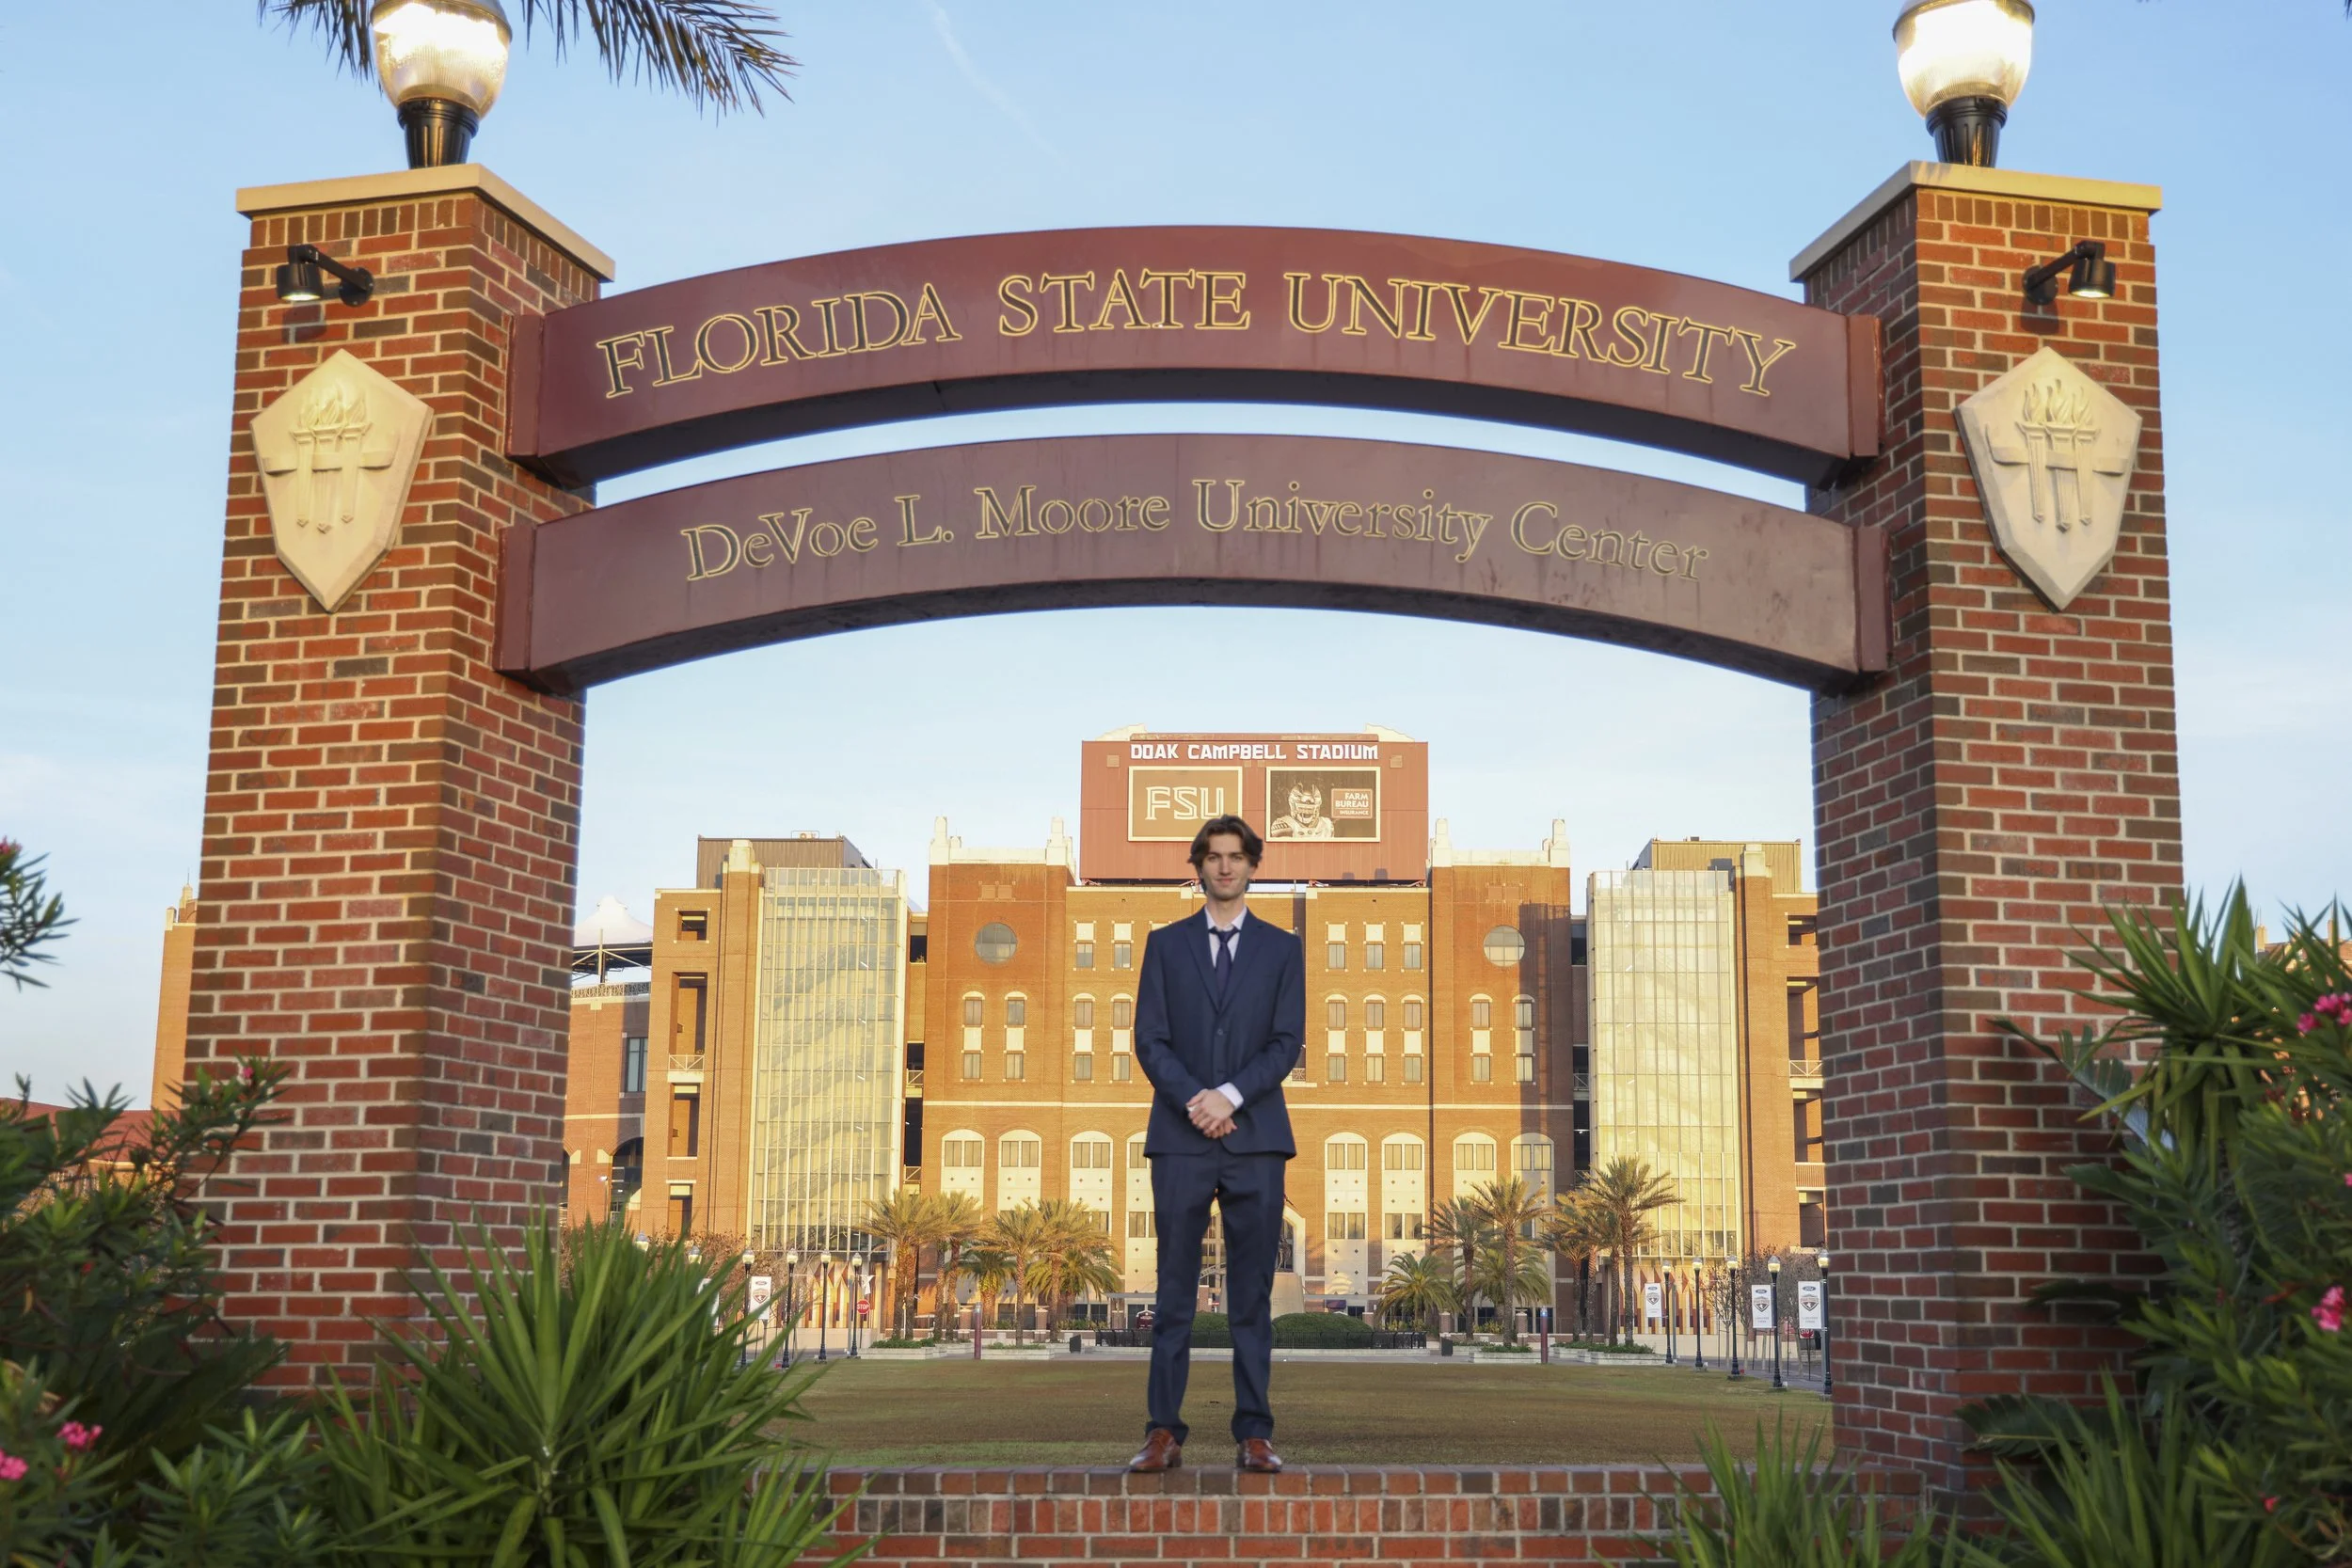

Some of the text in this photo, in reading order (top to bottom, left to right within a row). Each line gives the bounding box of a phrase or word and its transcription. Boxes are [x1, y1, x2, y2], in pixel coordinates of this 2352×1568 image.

[596, 268, 1796, 399] FLORIDA STATE UNIVERSITY
[680, 480, 1710, 582] DeVoe L. Moore University Center
[1130, 743, 1379, 760] DOAK CAMPBELL STADIUM
[1144, 785, 1225, 820] FSU
[1334, 800, 1369, 808] BUREAU
[1344, 792, 1369, 800] FARM
